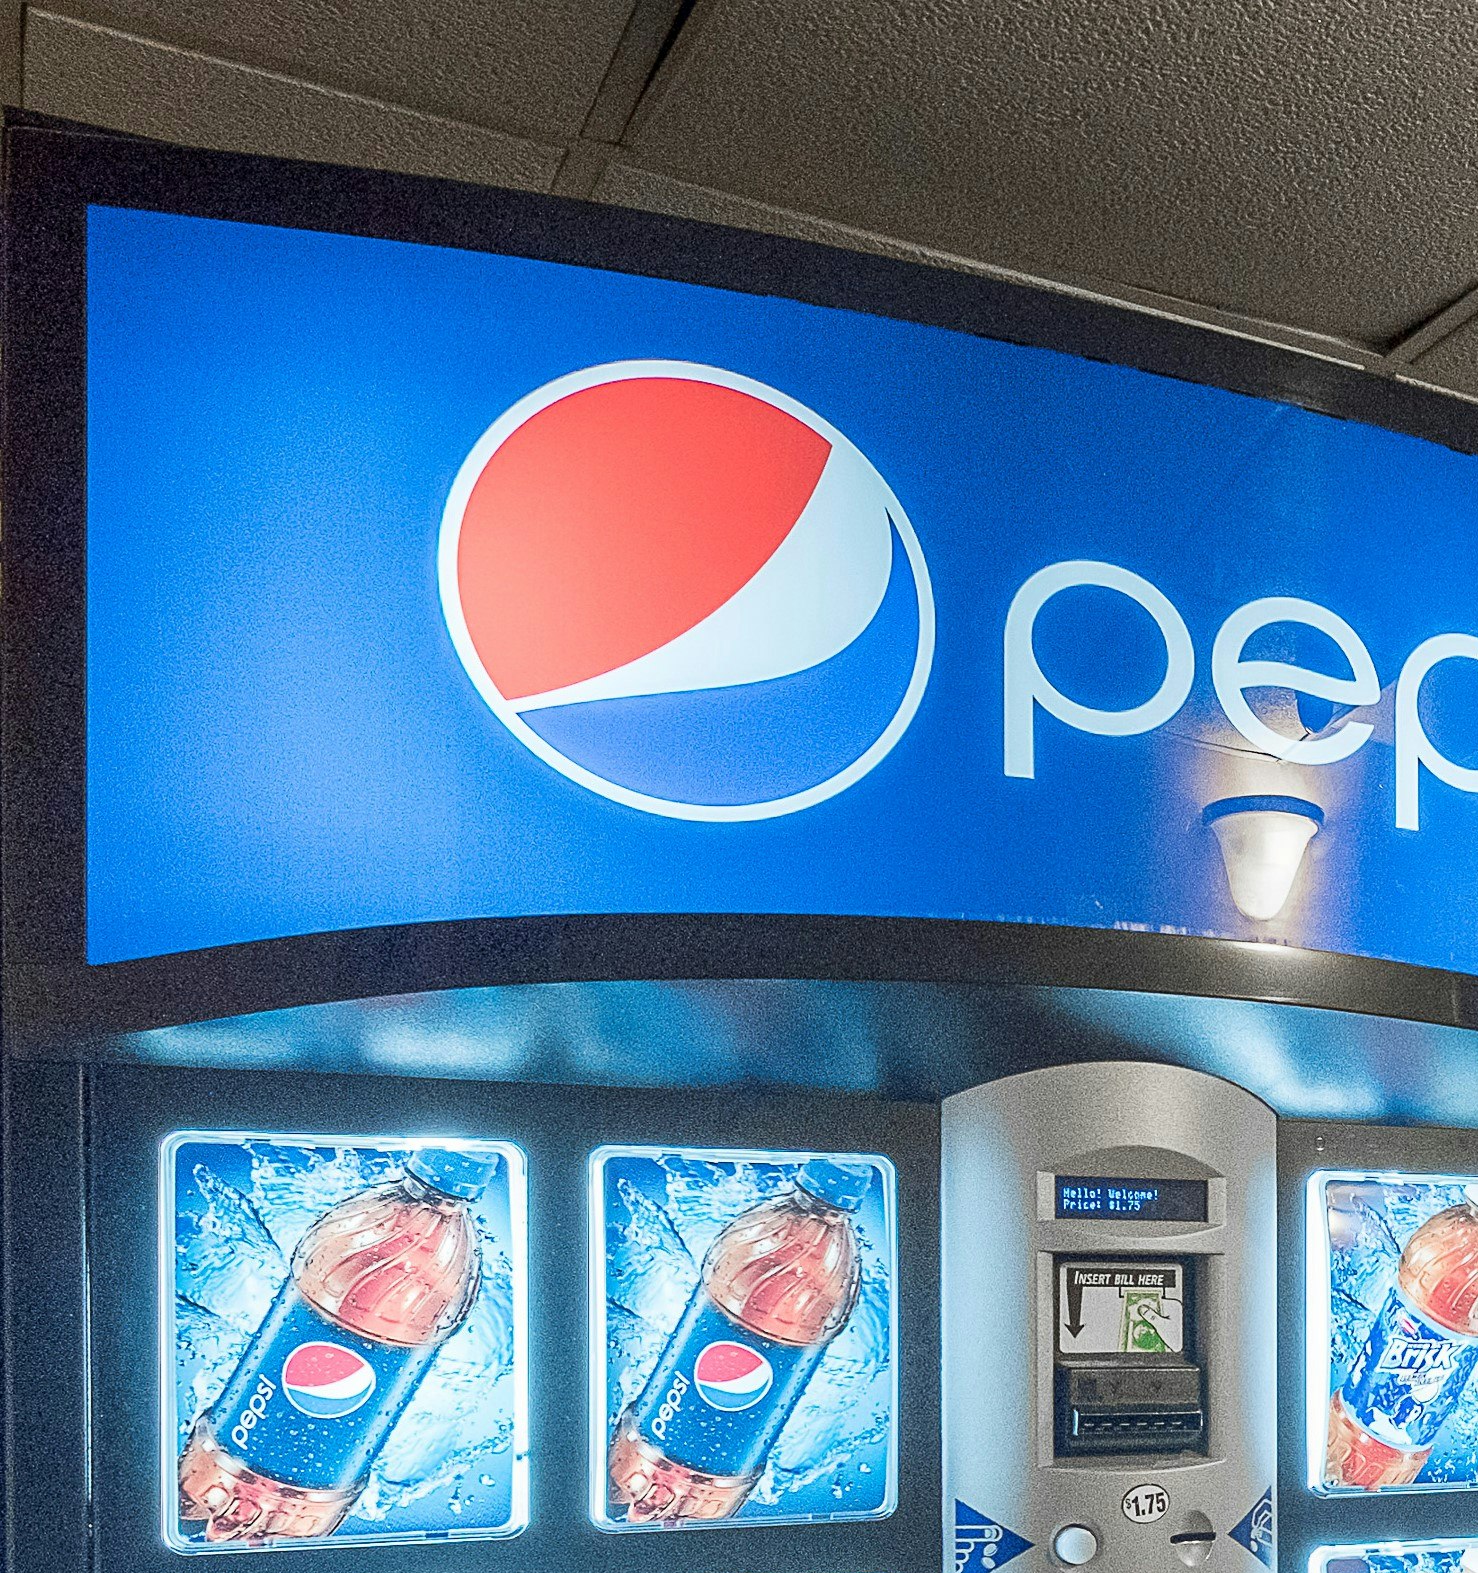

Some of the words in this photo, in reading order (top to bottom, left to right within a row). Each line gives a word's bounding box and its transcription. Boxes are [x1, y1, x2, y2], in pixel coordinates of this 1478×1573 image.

[1063, 1187, 1102, 1199] Hello!
[1107, 1188, 1159, 1200] Welcome!
[1063, 1199, 1102, 1210] Price:
[1107, 1200, 1141, 1211] $1.75
[1074, 1270, 1112, 1285] INSERT
[1114, 1274, 1135, 1286] BILL
[1138, 1274, 1165, 1286] HERE
[231, 1373, 277, 1451] pepsi
[651, 1370, 691, 1441] pepsi
[1125, 1491, 1167, 1518] $1.75
